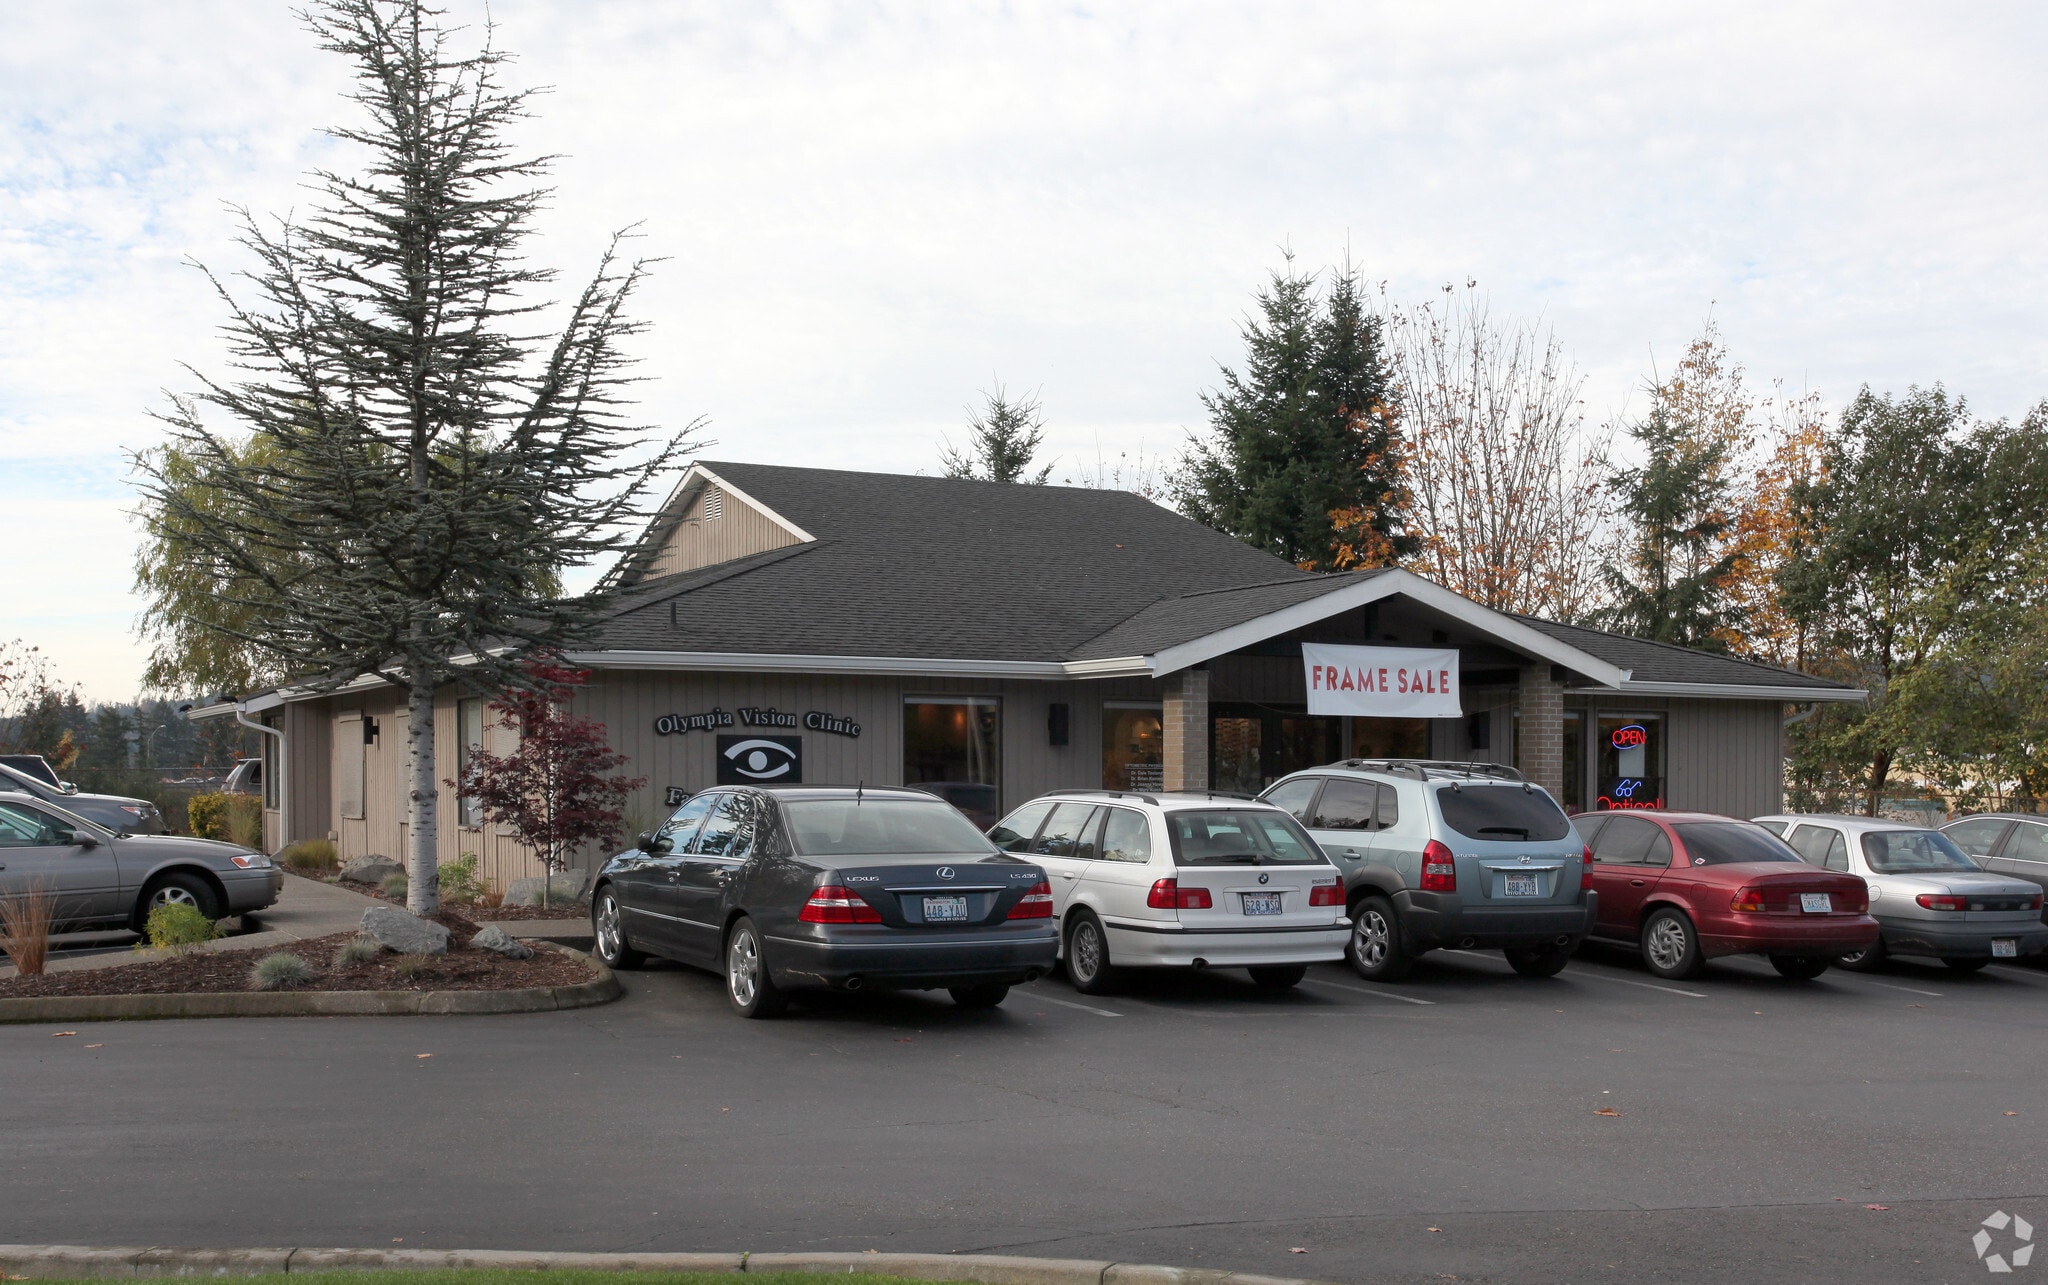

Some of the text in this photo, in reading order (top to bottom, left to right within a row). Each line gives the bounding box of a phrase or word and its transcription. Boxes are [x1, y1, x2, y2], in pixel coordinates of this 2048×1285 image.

[1312, 665, 1450, 694] FRAME SALE
[657, 708, 861, 736] Olympia Vision Clinic
[1612, 730, 1647, 745] OPEN
